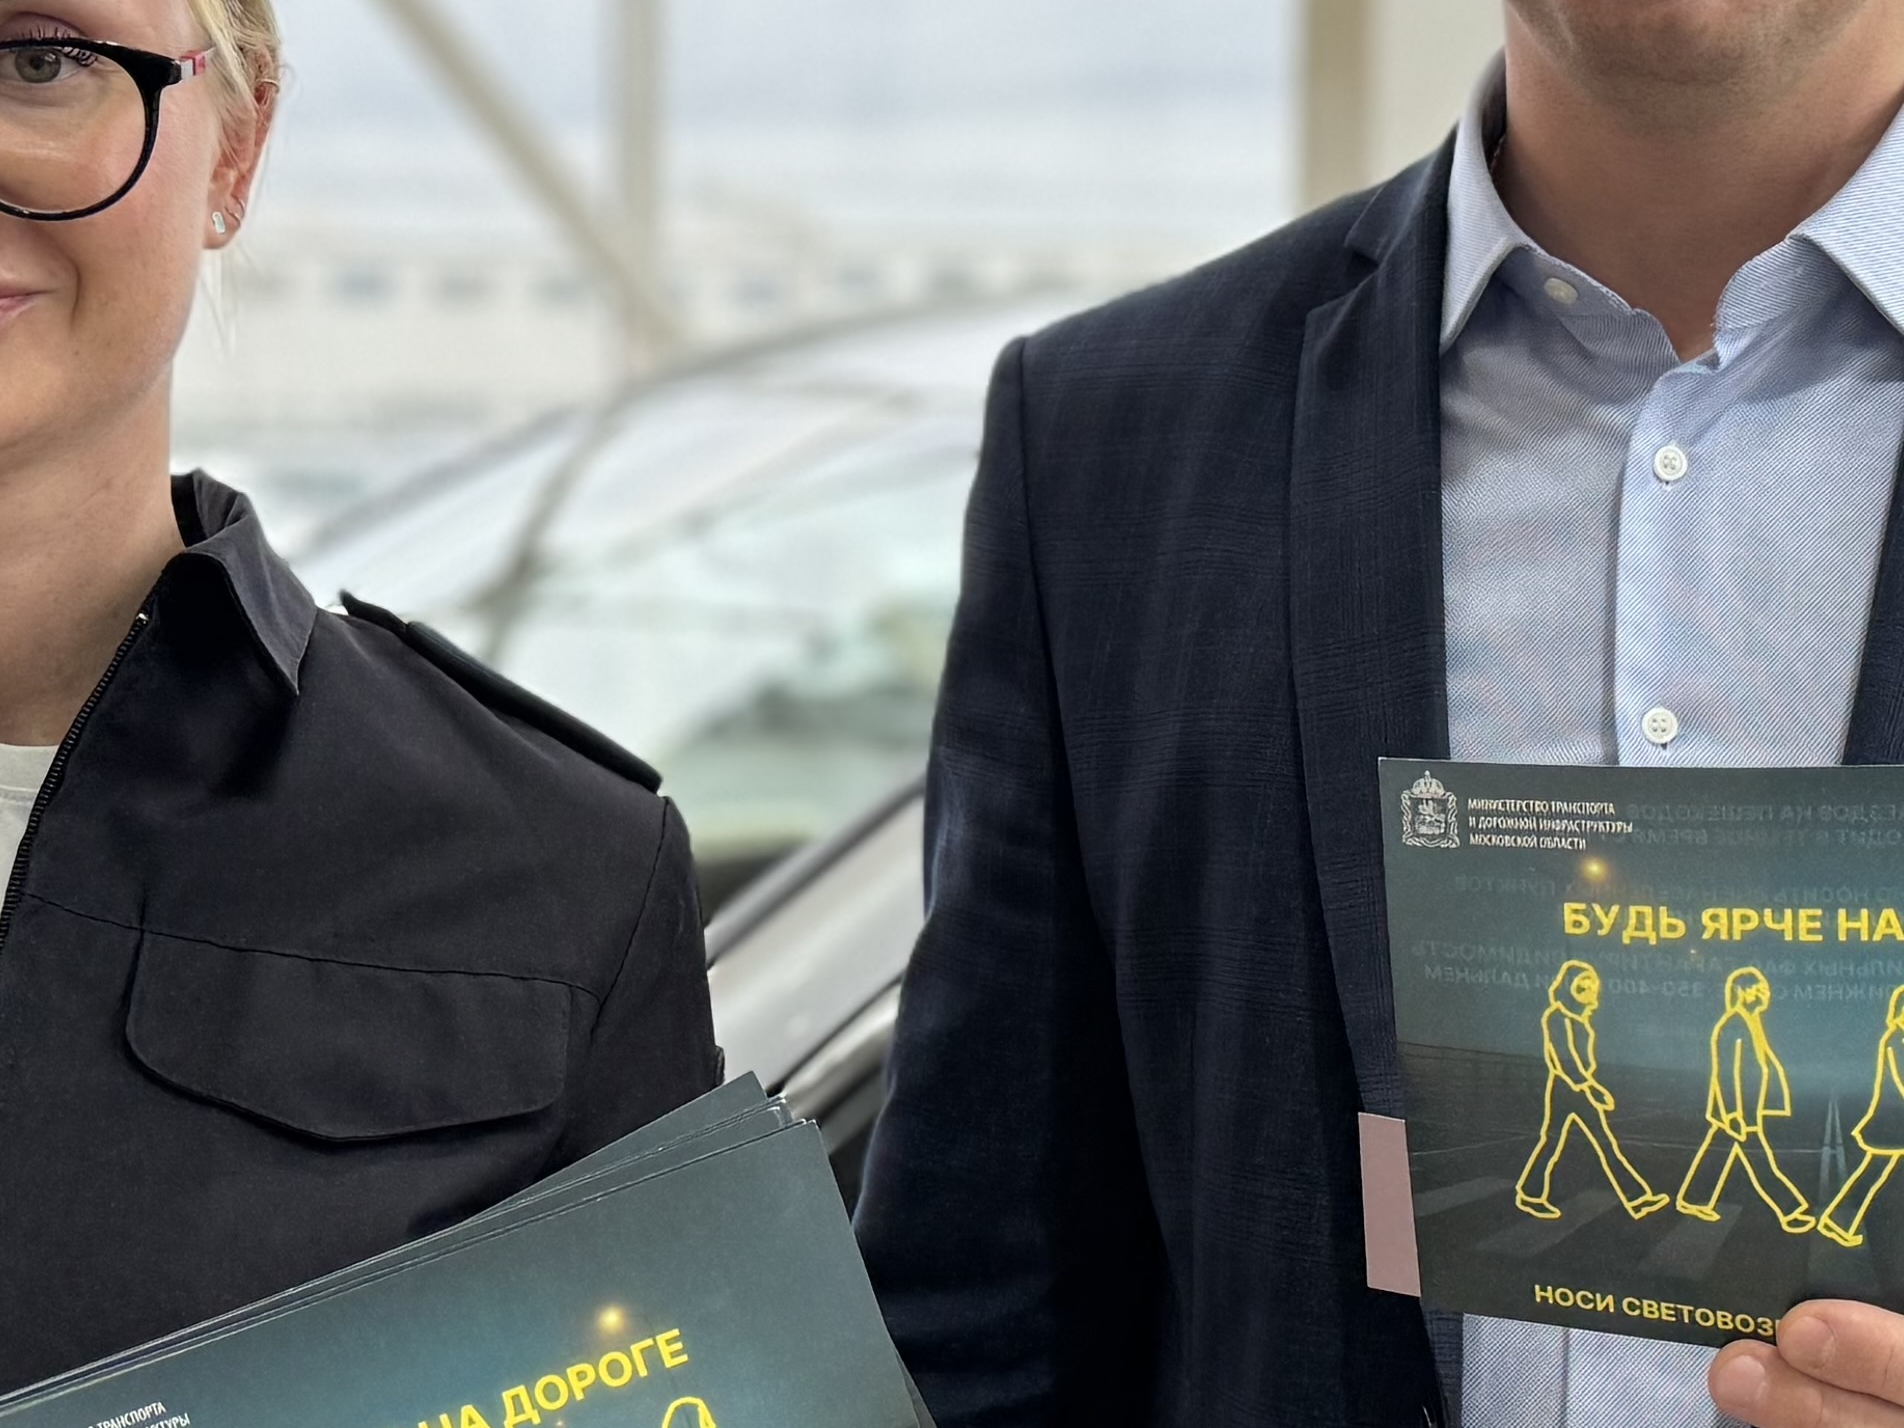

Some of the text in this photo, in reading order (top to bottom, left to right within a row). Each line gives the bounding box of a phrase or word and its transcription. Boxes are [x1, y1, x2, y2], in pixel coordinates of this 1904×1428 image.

[1468, 798, 1615, 815] МИНИСТЕРСТВО ТРАНСПОРТА
[1469, 816, 1633, 834] И ДОРОЖНОЙ ИНФРАСТРУКТУРЫ
[1470, 834, 1537, 849] МОСКОВСКОЙ
[1539, 836, 1586, 850] ОБЛАСТИ
[1564, 903, 1687, 945] БУДЬ
[1702, 908, 1823, 943] ЯРЧЕ
[1535, 1285, 1614, 1312] НОСИ
